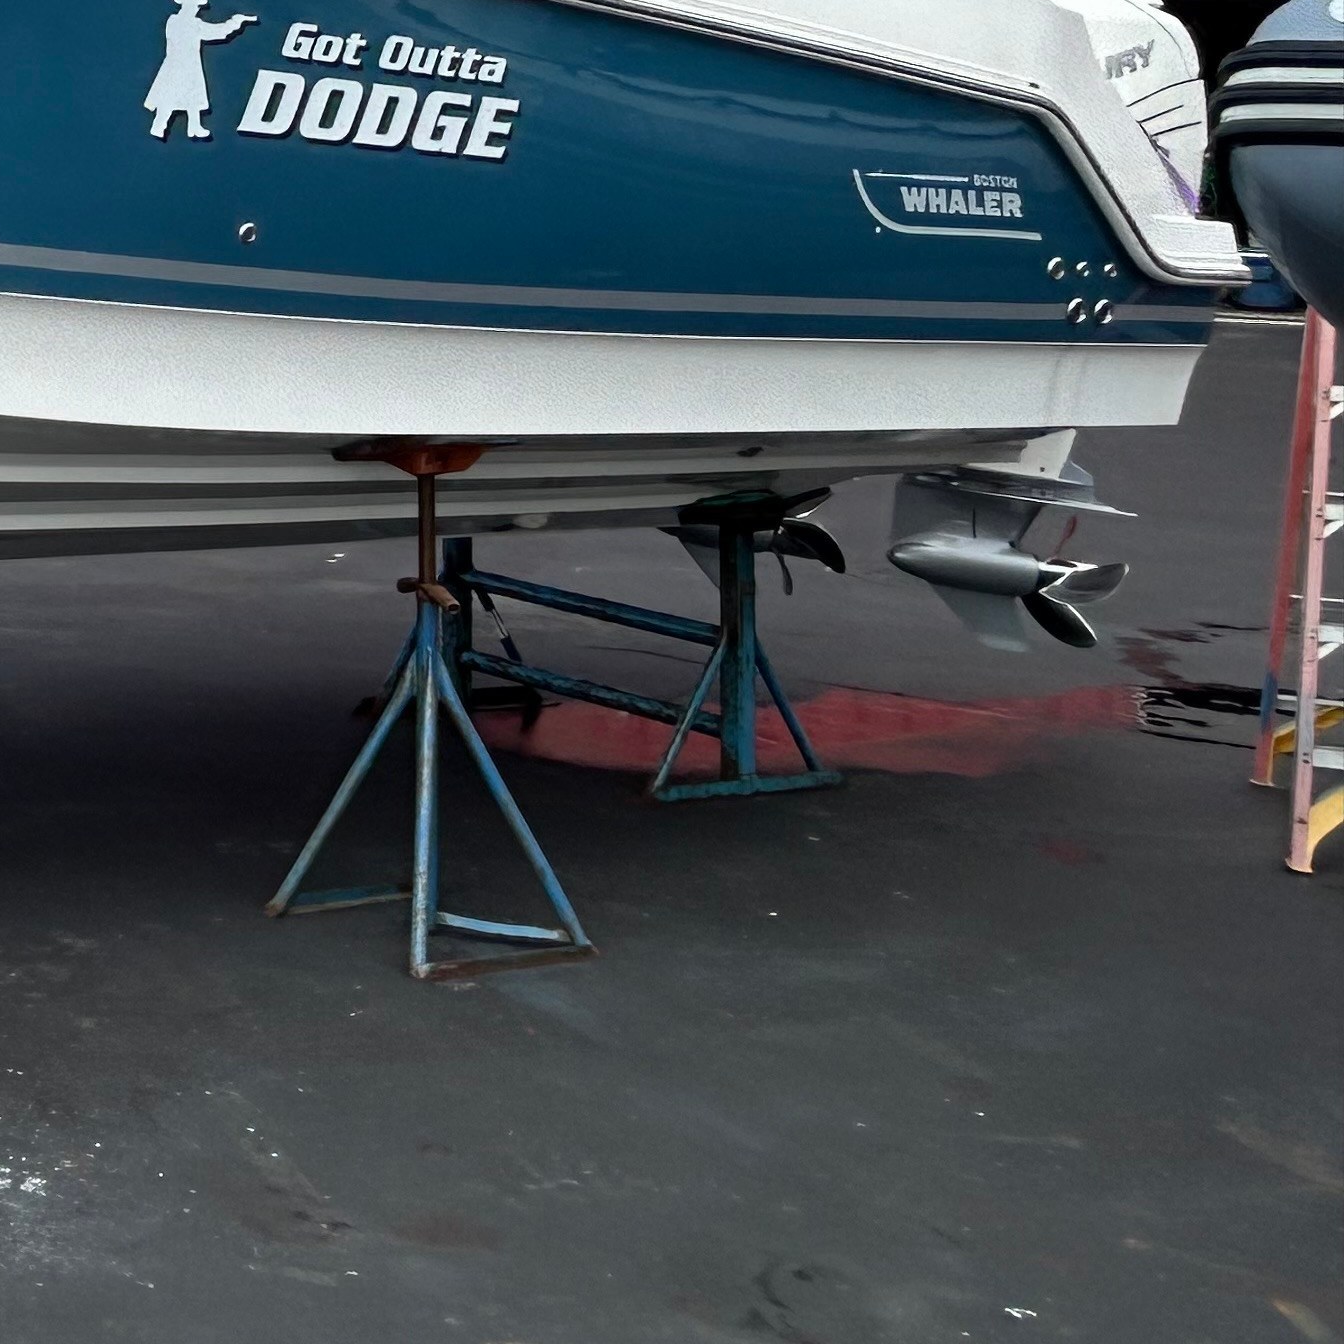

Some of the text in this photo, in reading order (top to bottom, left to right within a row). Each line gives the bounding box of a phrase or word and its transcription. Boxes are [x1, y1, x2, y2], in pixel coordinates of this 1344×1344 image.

[280, 22, 508, 84] Got Outta
[236, 68, 521, 160] DODGE
[899, 186, 1024, 218] WHALER
[973, 173, 1018, 189] BOSTON
